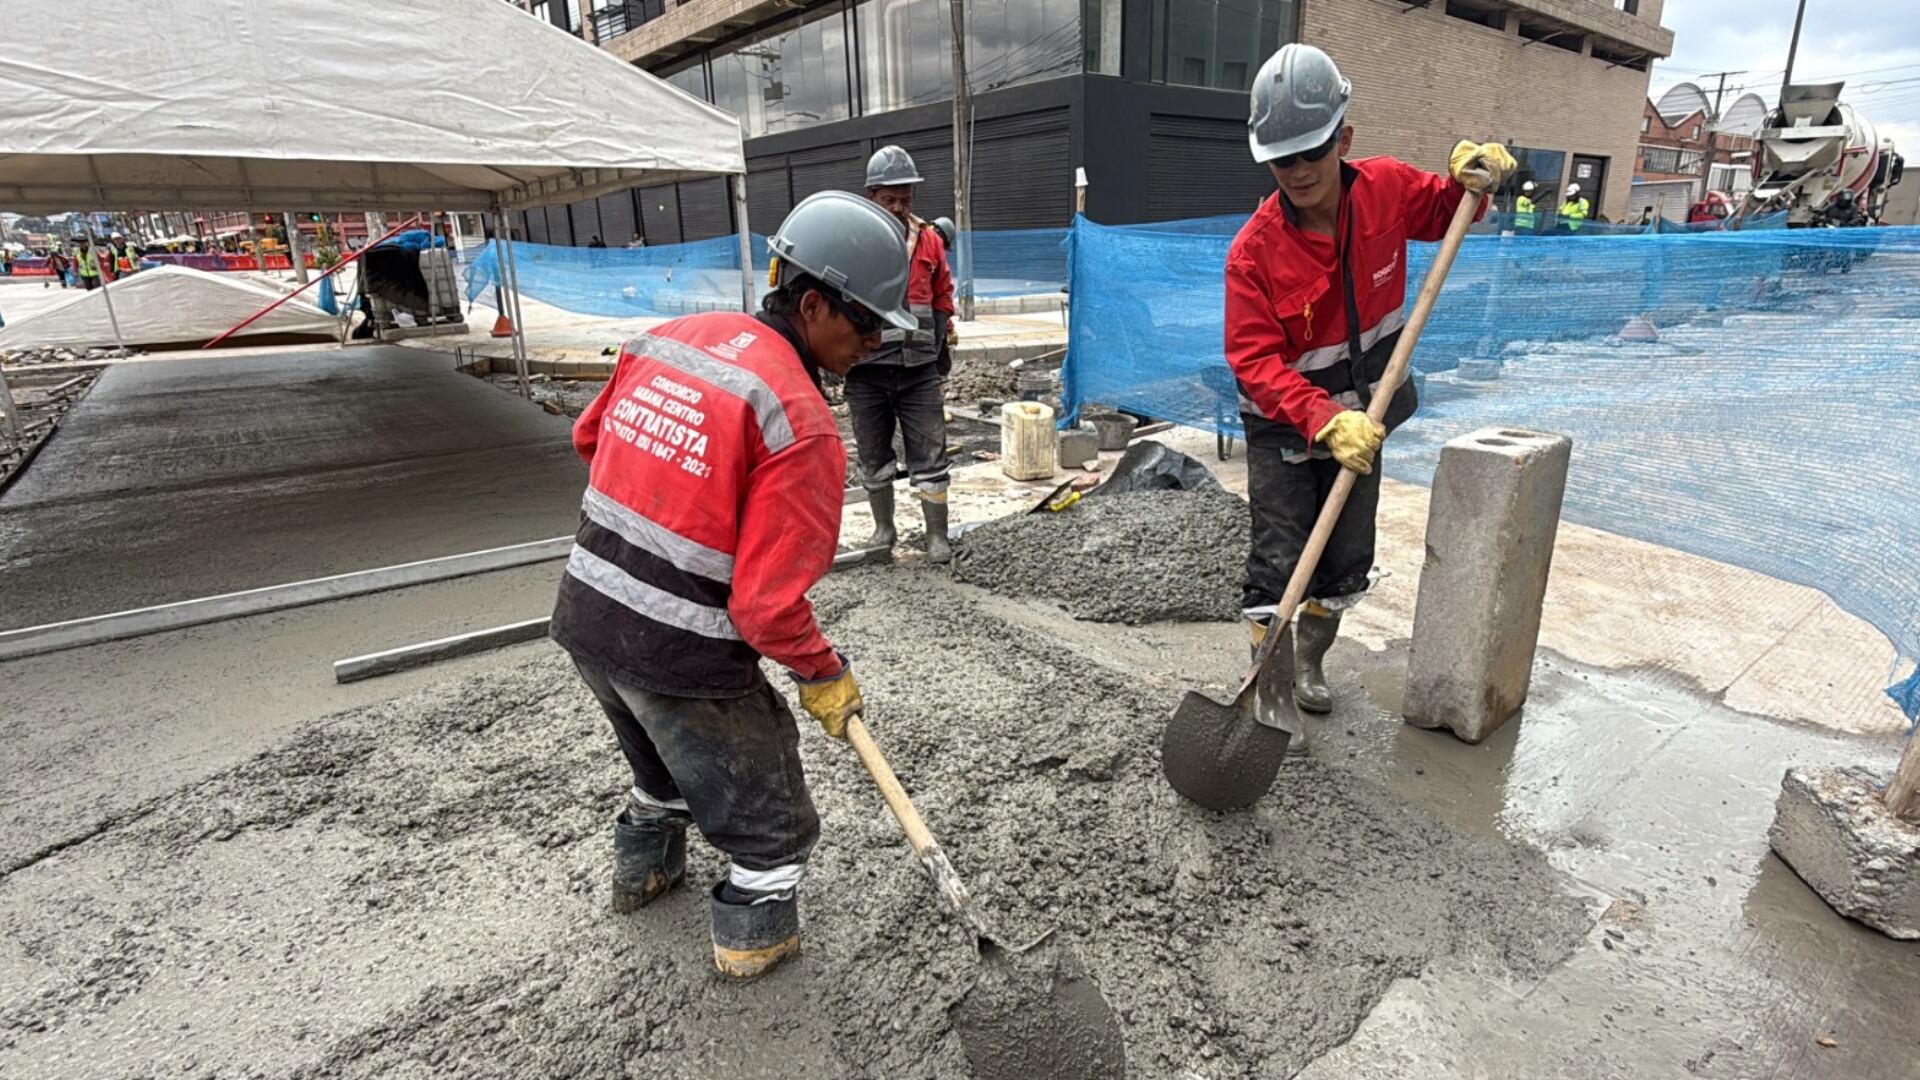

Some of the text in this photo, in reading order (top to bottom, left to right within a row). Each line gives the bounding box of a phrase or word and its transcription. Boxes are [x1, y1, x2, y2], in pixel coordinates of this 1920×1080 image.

[650, 375, 703, 404] CONSORCIO
[662, 399, 704, 426] CENTRO
[613, 398, 708, 457] CONTRATISTA
